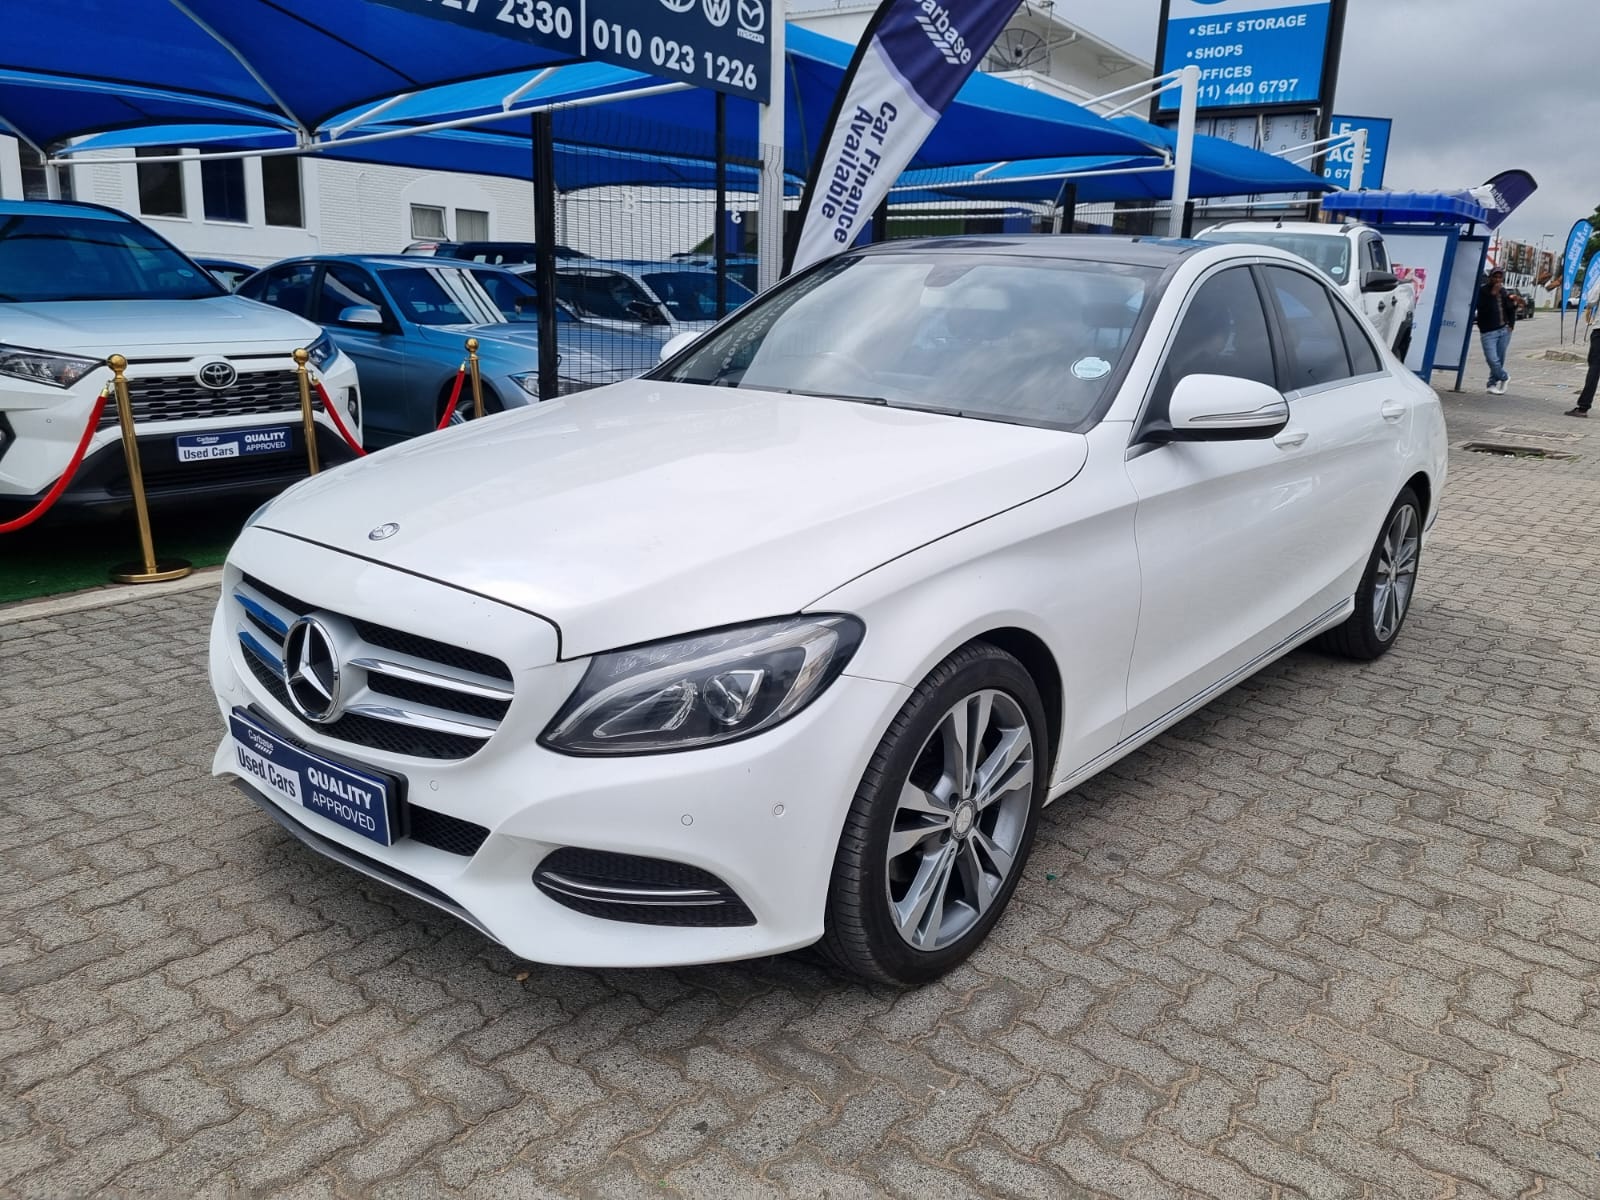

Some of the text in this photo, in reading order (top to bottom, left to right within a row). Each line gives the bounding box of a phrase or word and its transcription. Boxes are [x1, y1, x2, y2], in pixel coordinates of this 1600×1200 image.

[496, 0, 573, 39] 2330
[914, 0, 972, 64] arbase
[1197, 14, 1307, 36] SELF STORAGE
[593, 19, 757, 90] 010 023 1226
[1195, 44, 1243, 59] SHOPS
[1198, 65, 1252, 80] FFICES
[1225, 82, 1254, 96] 440
[1258, 78, 1299, 94] 6797
[821, 105, 875, 219] Available
[833, 101, 898, 243] Car Finance
[184, 446, 234, 460] Used Cars
[244, 432, 285, 443] QUALITY
[246, 441, 286, 452] APPROVED
[237, 746, 297, 798] Used Cars
[307, 766, 372, 810] QUALITY
[312, 790, 376, 832] APPROVED
